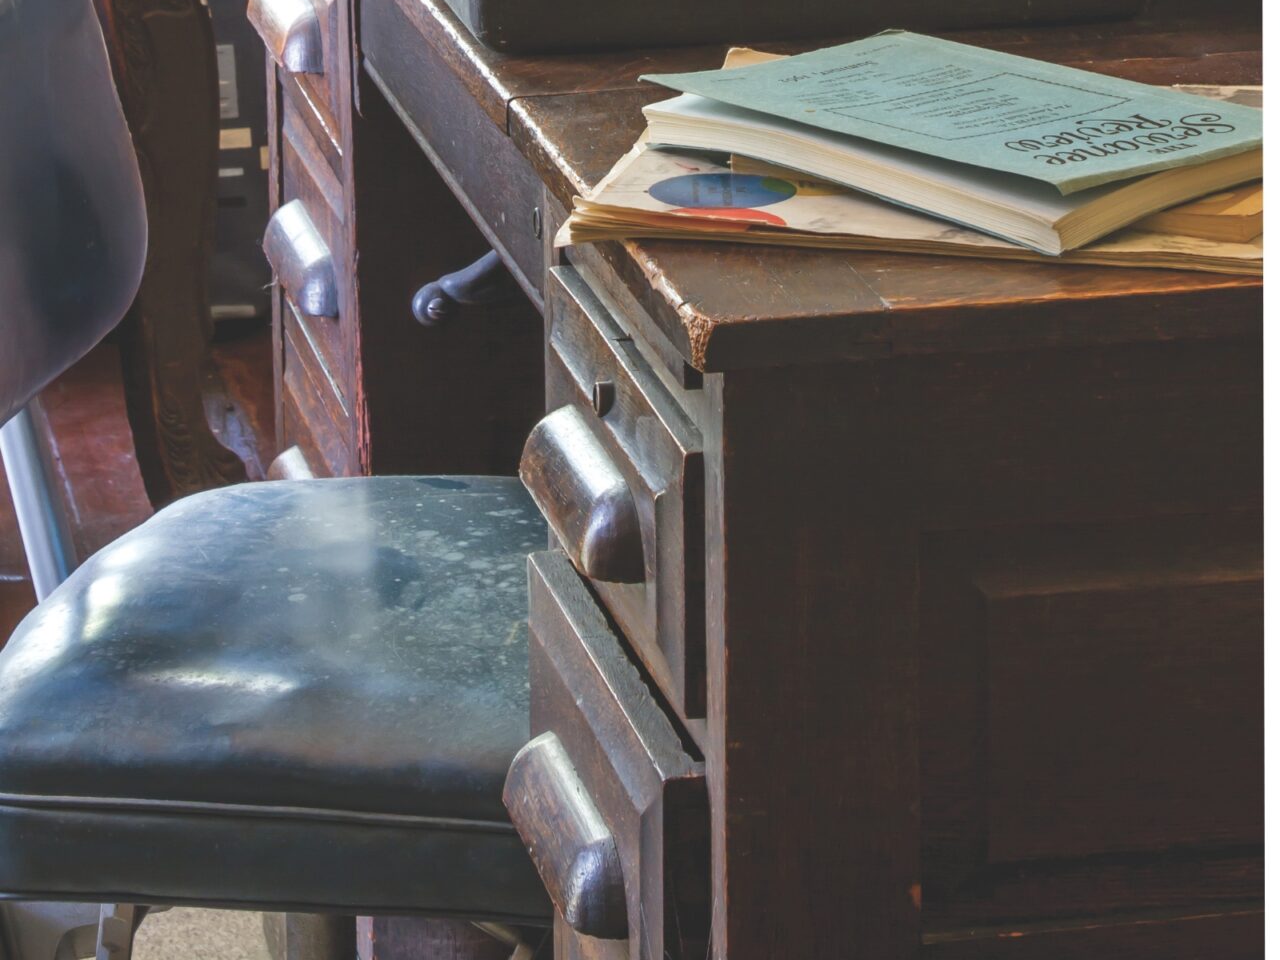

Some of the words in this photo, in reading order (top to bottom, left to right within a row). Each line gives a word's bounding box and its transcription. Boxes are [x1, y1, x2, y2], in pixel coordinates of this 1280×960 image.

[1003, 112, 1173, 154] Review
[1033, 112, 1237, 166] Sewanee
[1147, 141, 1197, 155] THE
